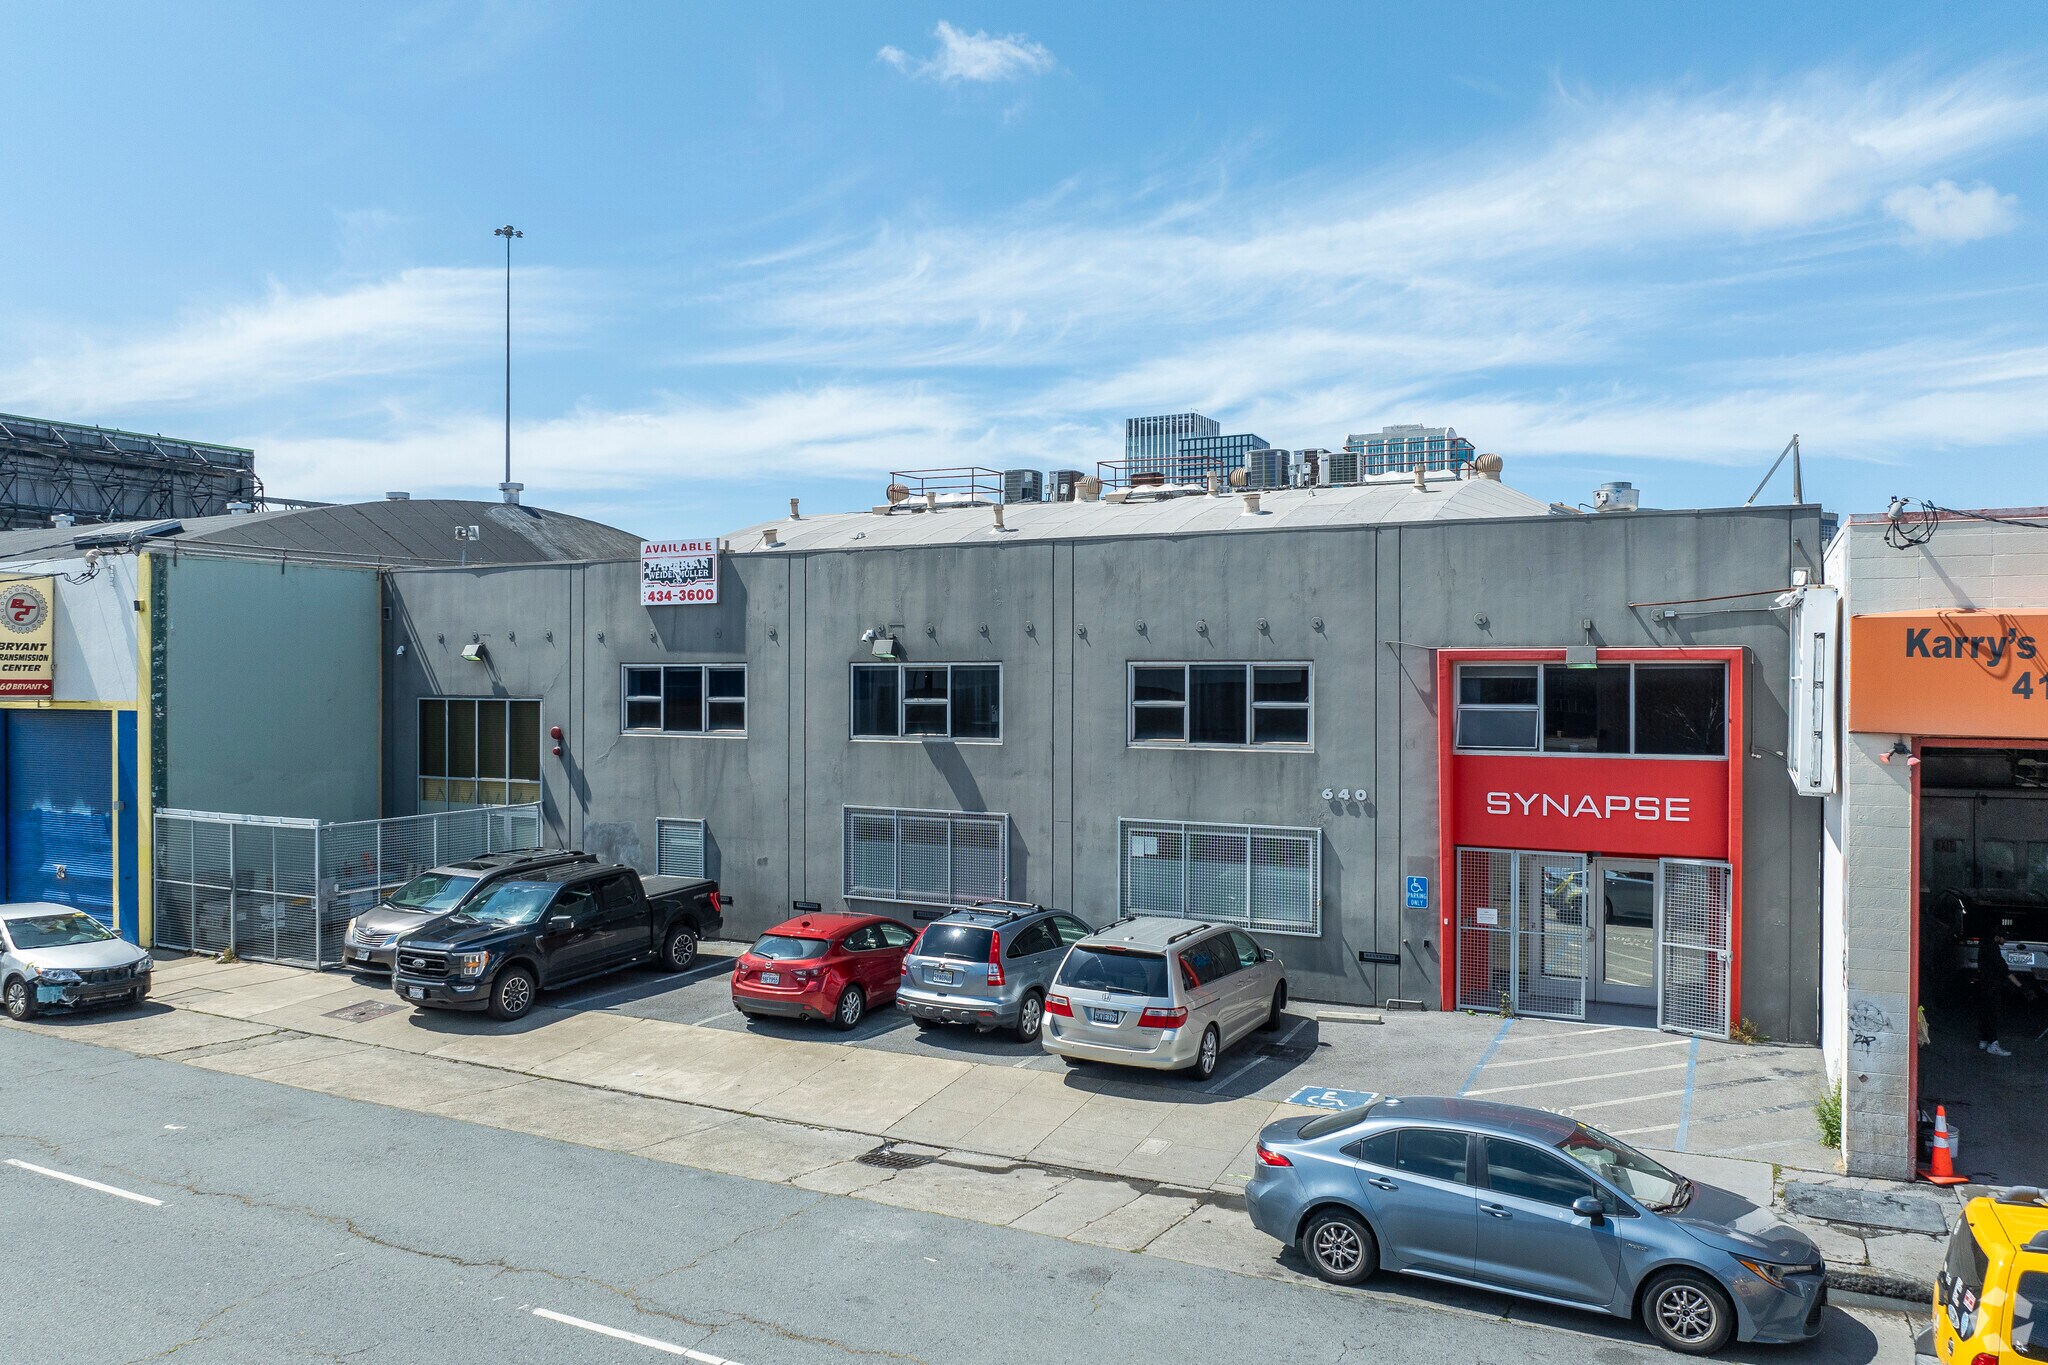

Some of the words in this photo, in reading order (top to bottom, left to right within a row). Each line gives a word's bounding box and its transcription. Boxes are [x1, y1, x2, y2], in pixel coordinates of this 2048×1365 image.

[645, 542, 712, 554] AVAILABLE
[647, 589, 714, 602] 434-3600
[1905, 628, 2037, 667] Karry's
[2, 664, 41, 672] CENTER
[1321, 788, 1367, 801] 640
[1486, 791, 1690, 822] SYNAPSE
